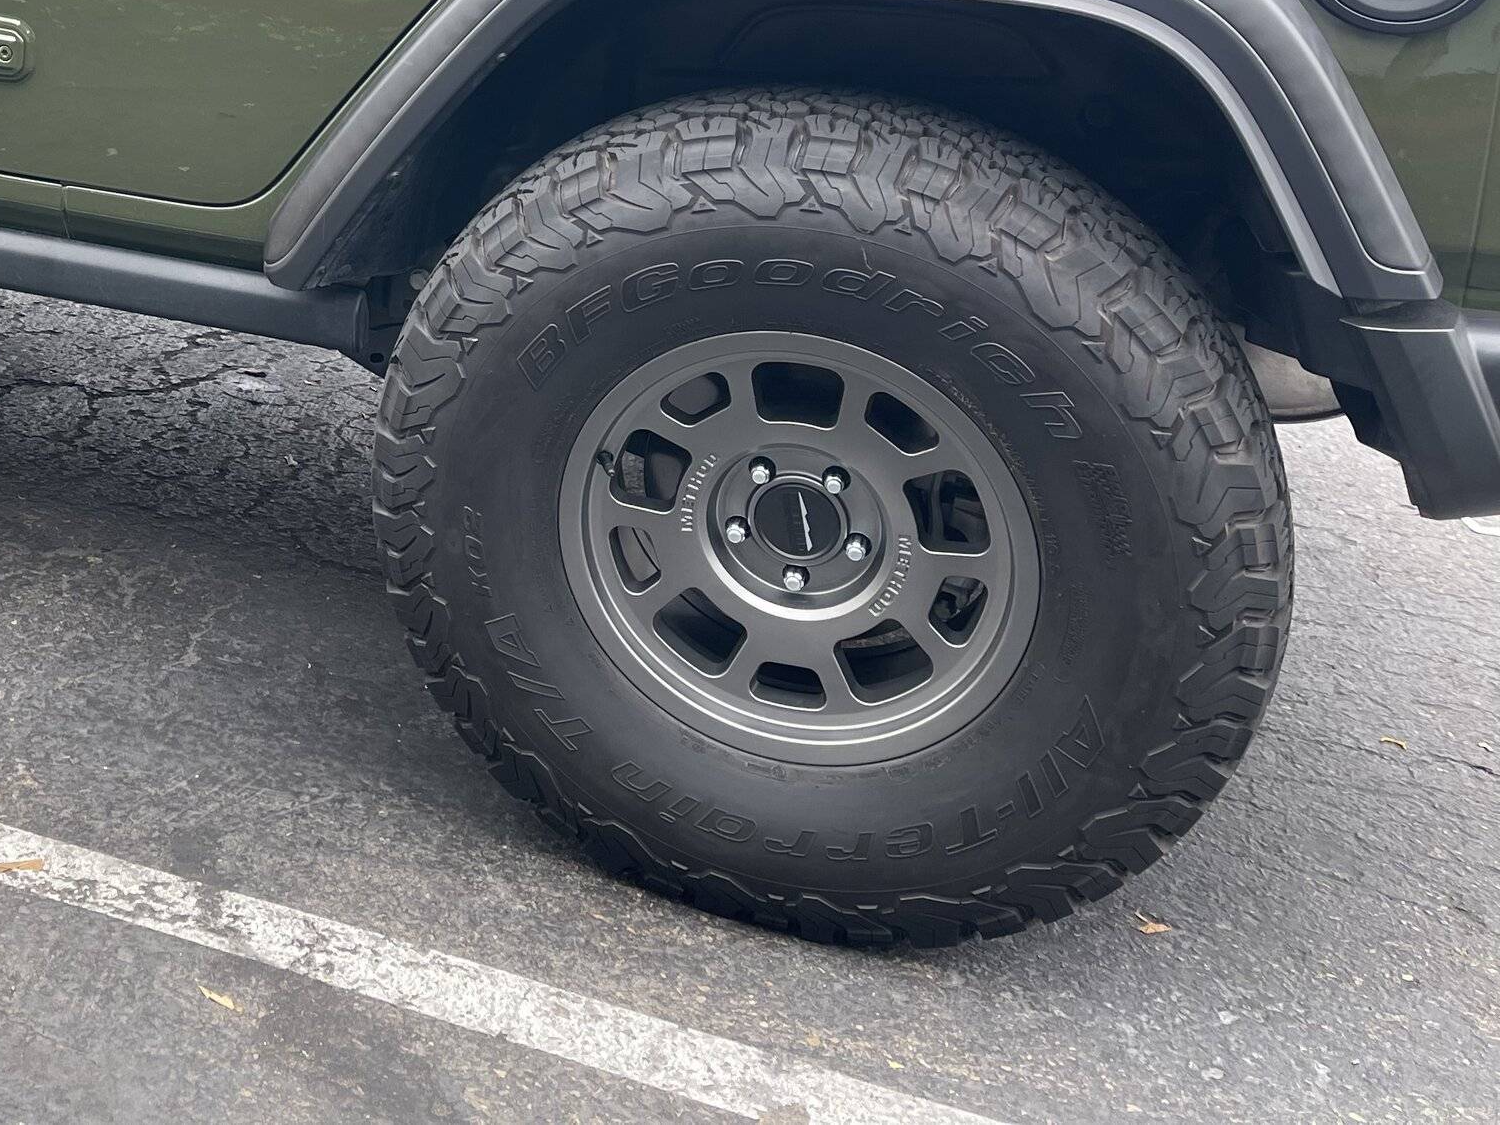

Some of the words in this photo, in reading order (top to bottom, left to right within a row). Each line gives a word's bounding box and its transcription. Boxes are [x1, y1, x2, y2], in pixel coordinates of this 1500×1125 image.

[514, 258, 1084, 440] BFGoodrich
[680, 453, 719, 533] METHOD
[867, 533, 913, 618] METHOD
